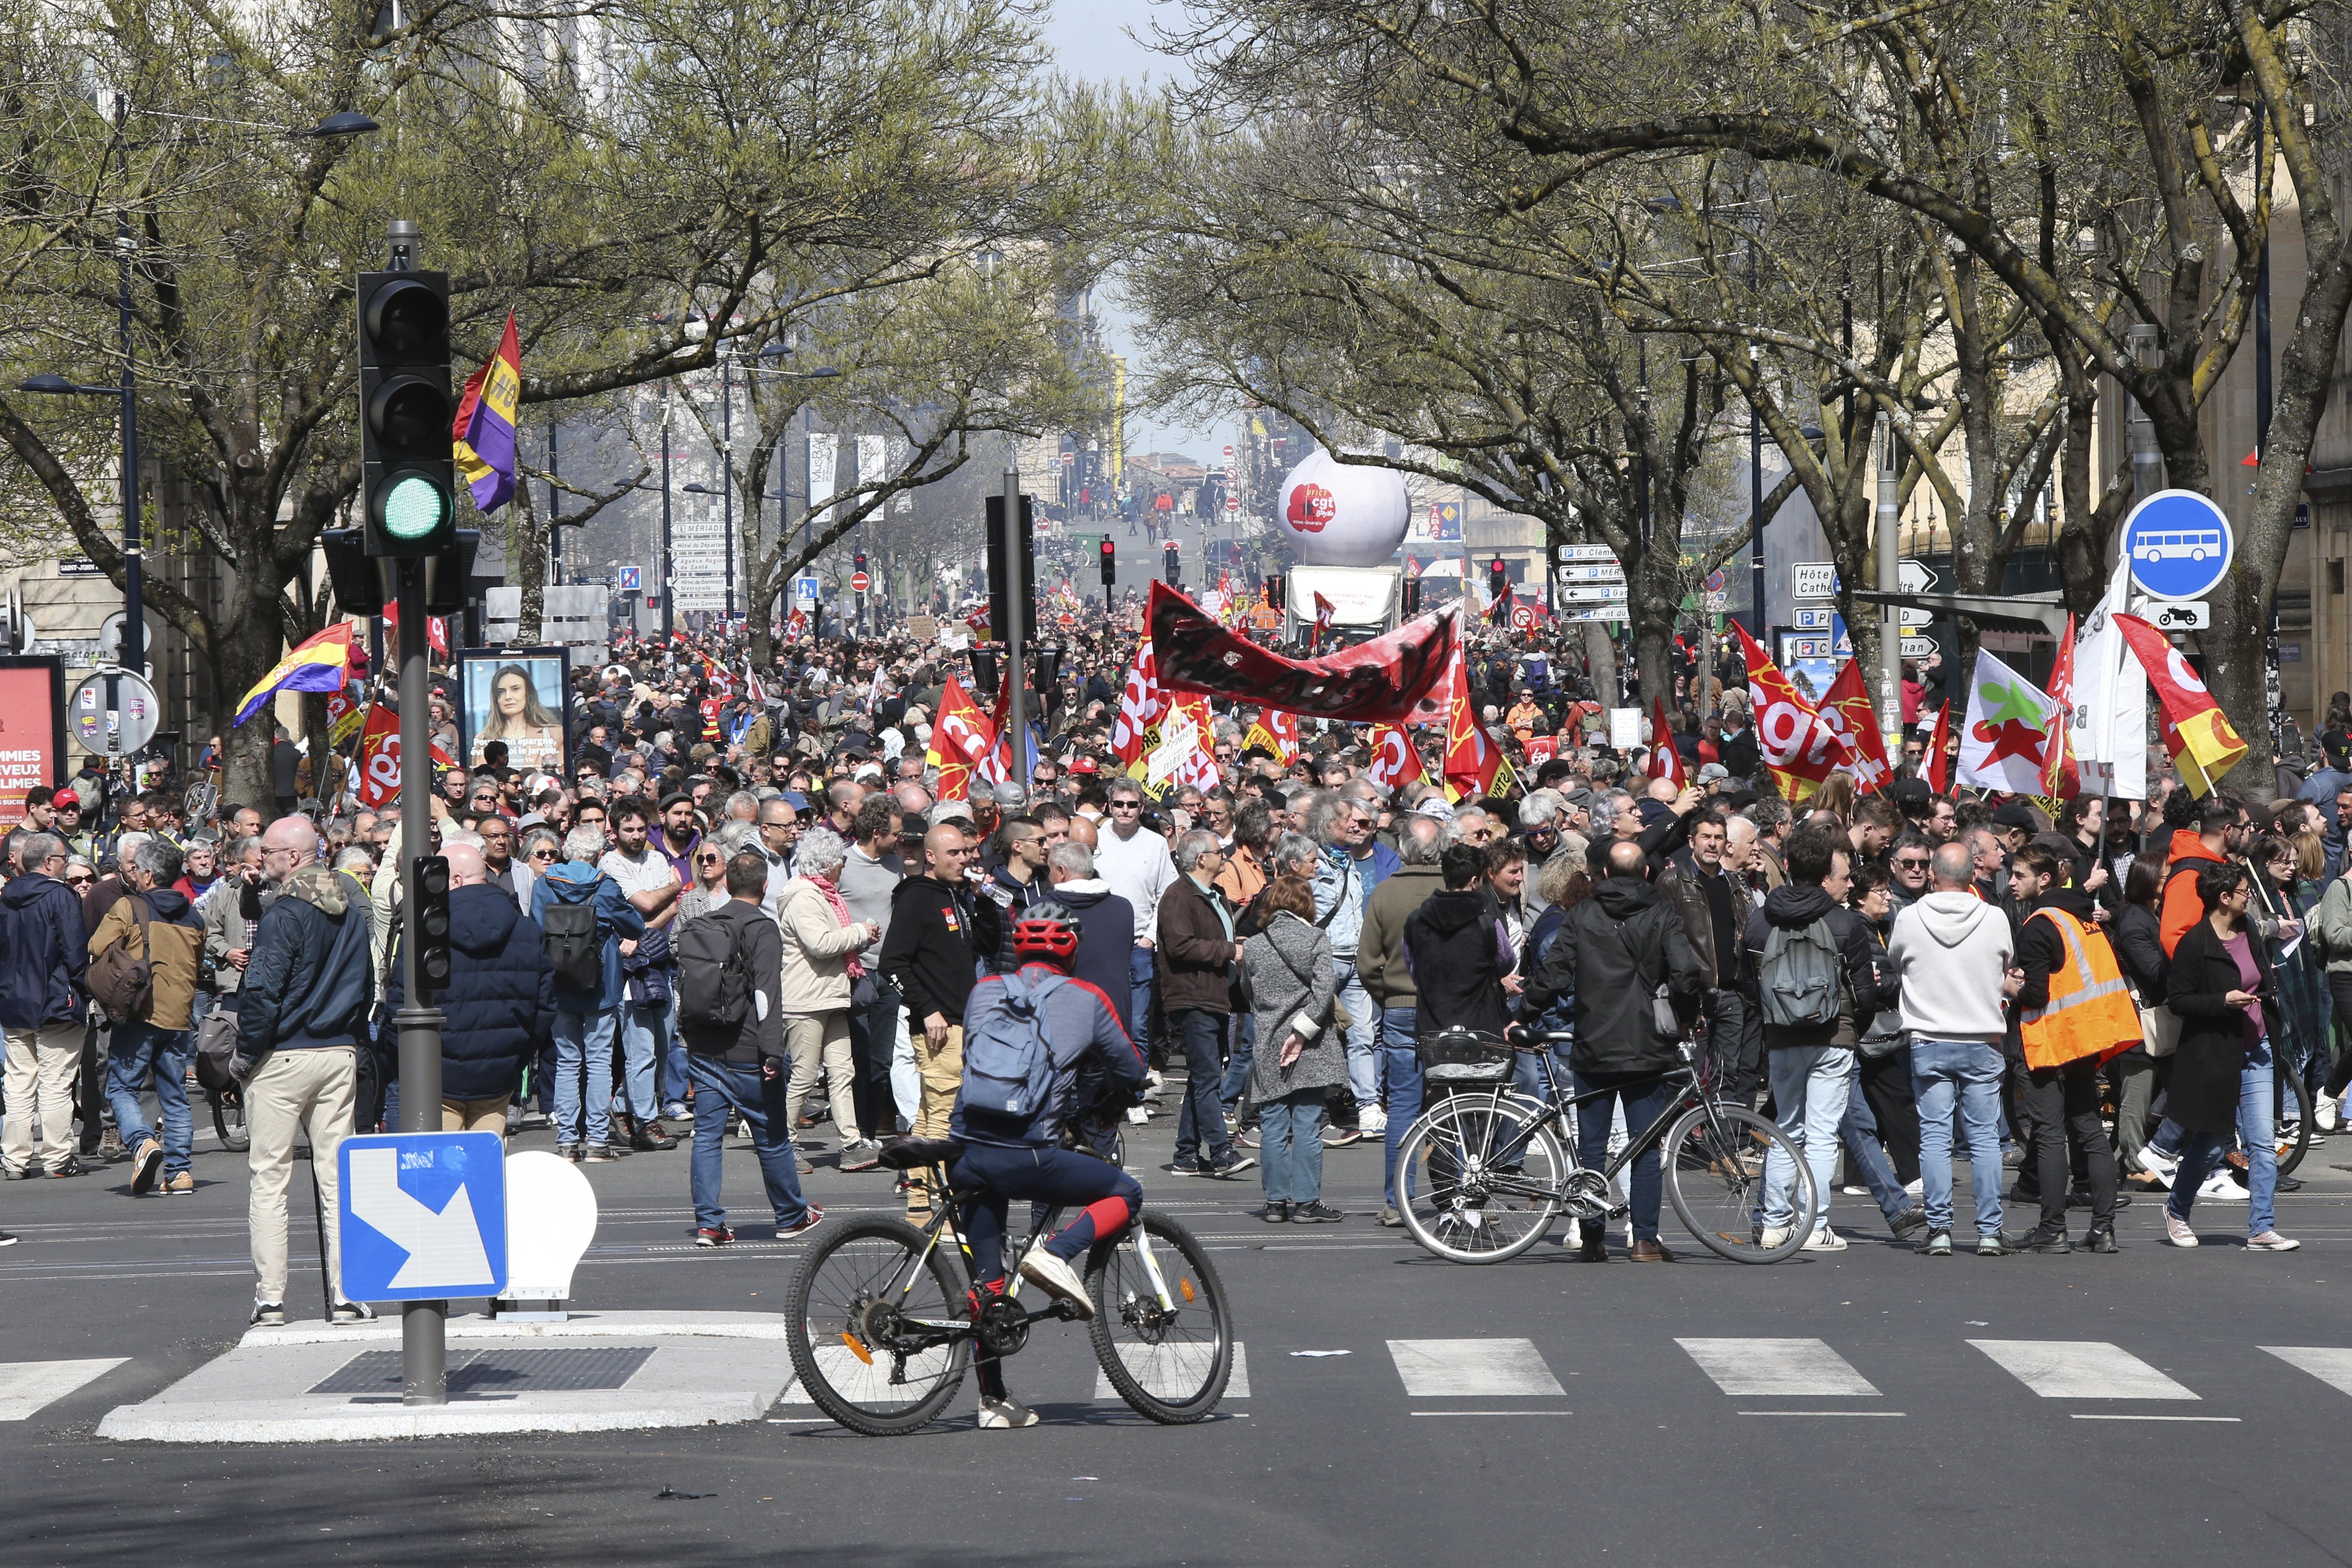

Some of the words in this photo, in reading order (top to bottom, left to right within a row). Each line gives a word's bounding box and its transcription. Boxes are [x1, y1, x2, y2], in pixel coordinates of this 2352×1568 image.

[1312, 496, 1334, 510] cgt
[1431, 506, 1439, 538] TABAC
[518, 735, 557, 748] épargne,
[528, 747, 559, 757] jargon.
